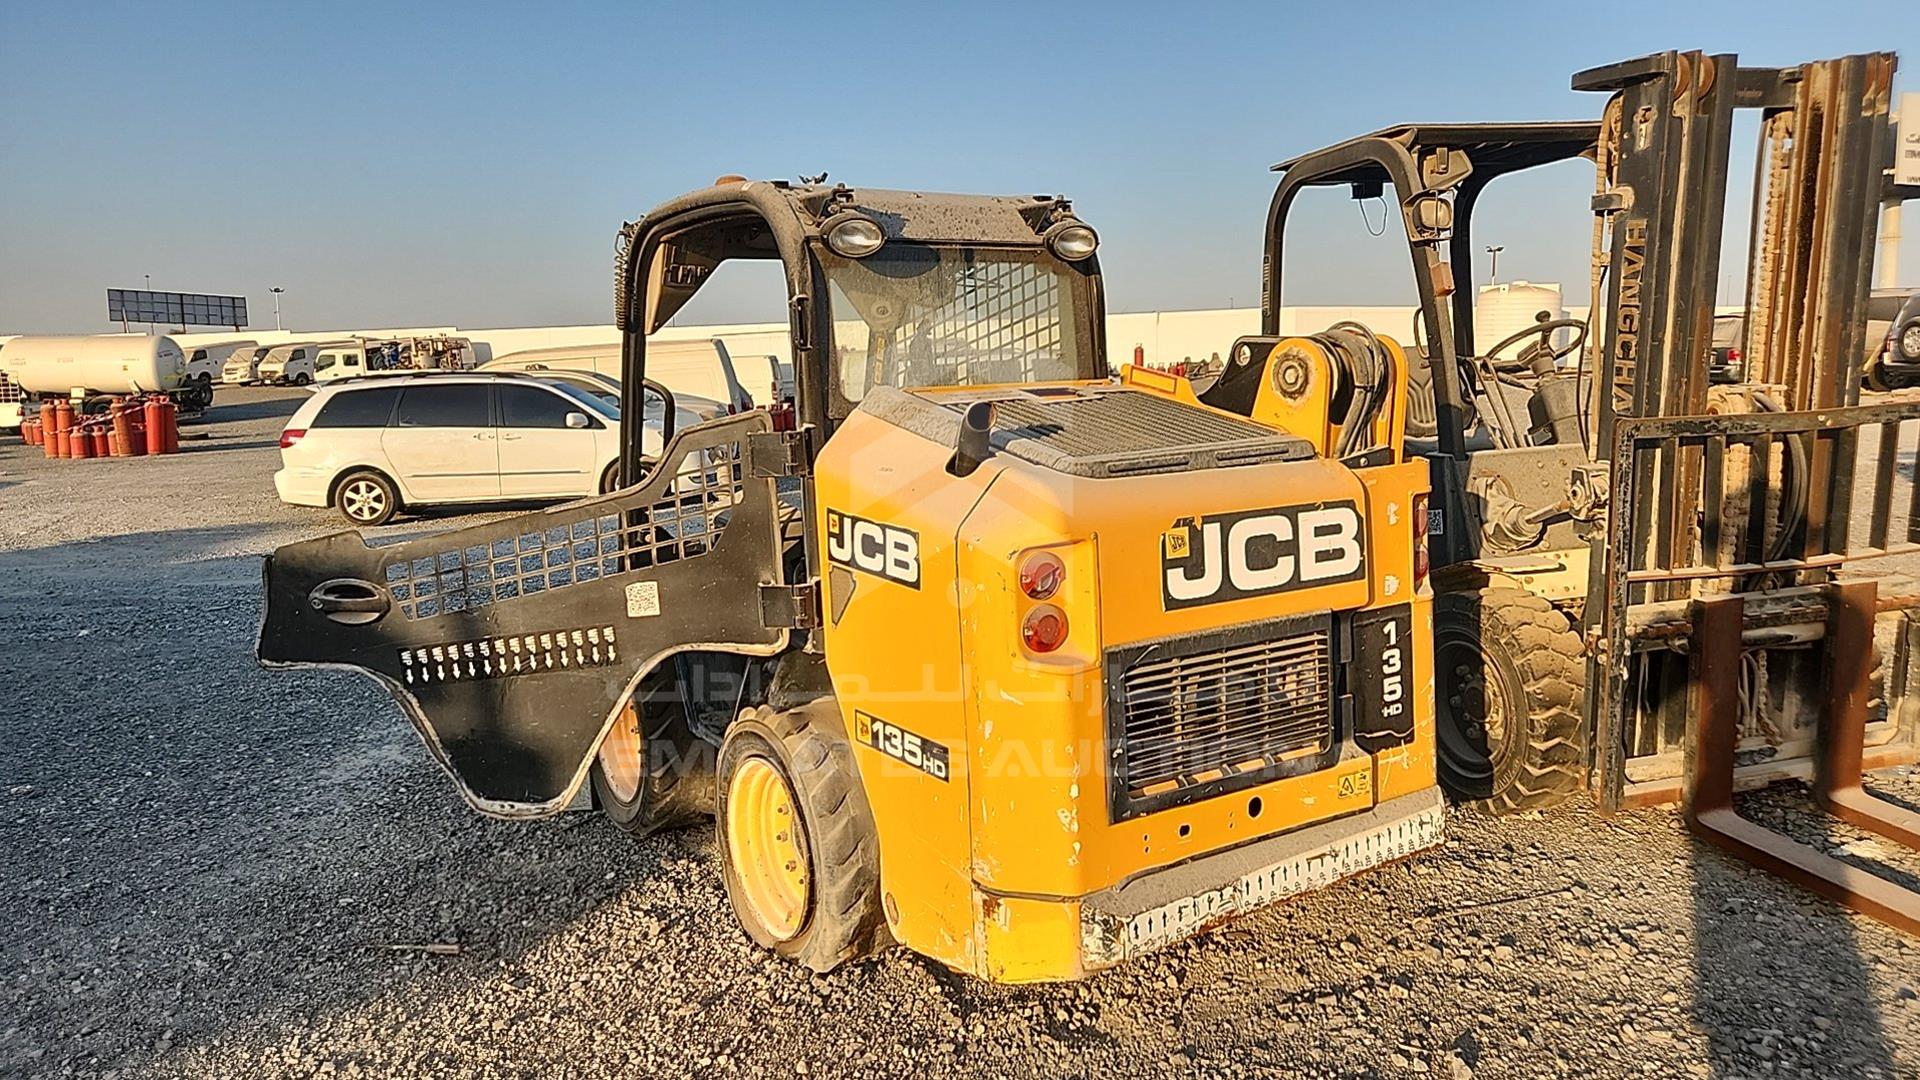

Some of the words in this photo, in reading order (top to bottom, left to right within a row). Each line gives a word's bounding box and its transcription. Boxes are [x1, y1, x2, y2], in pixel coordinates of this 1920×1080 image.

[1612, 218, 1649, 417] HANGCHA
[829, 516, 918, 583] JCB
[1167, 507, 1361, 600] JCB
[1382, 703, 1403, 718] HD
